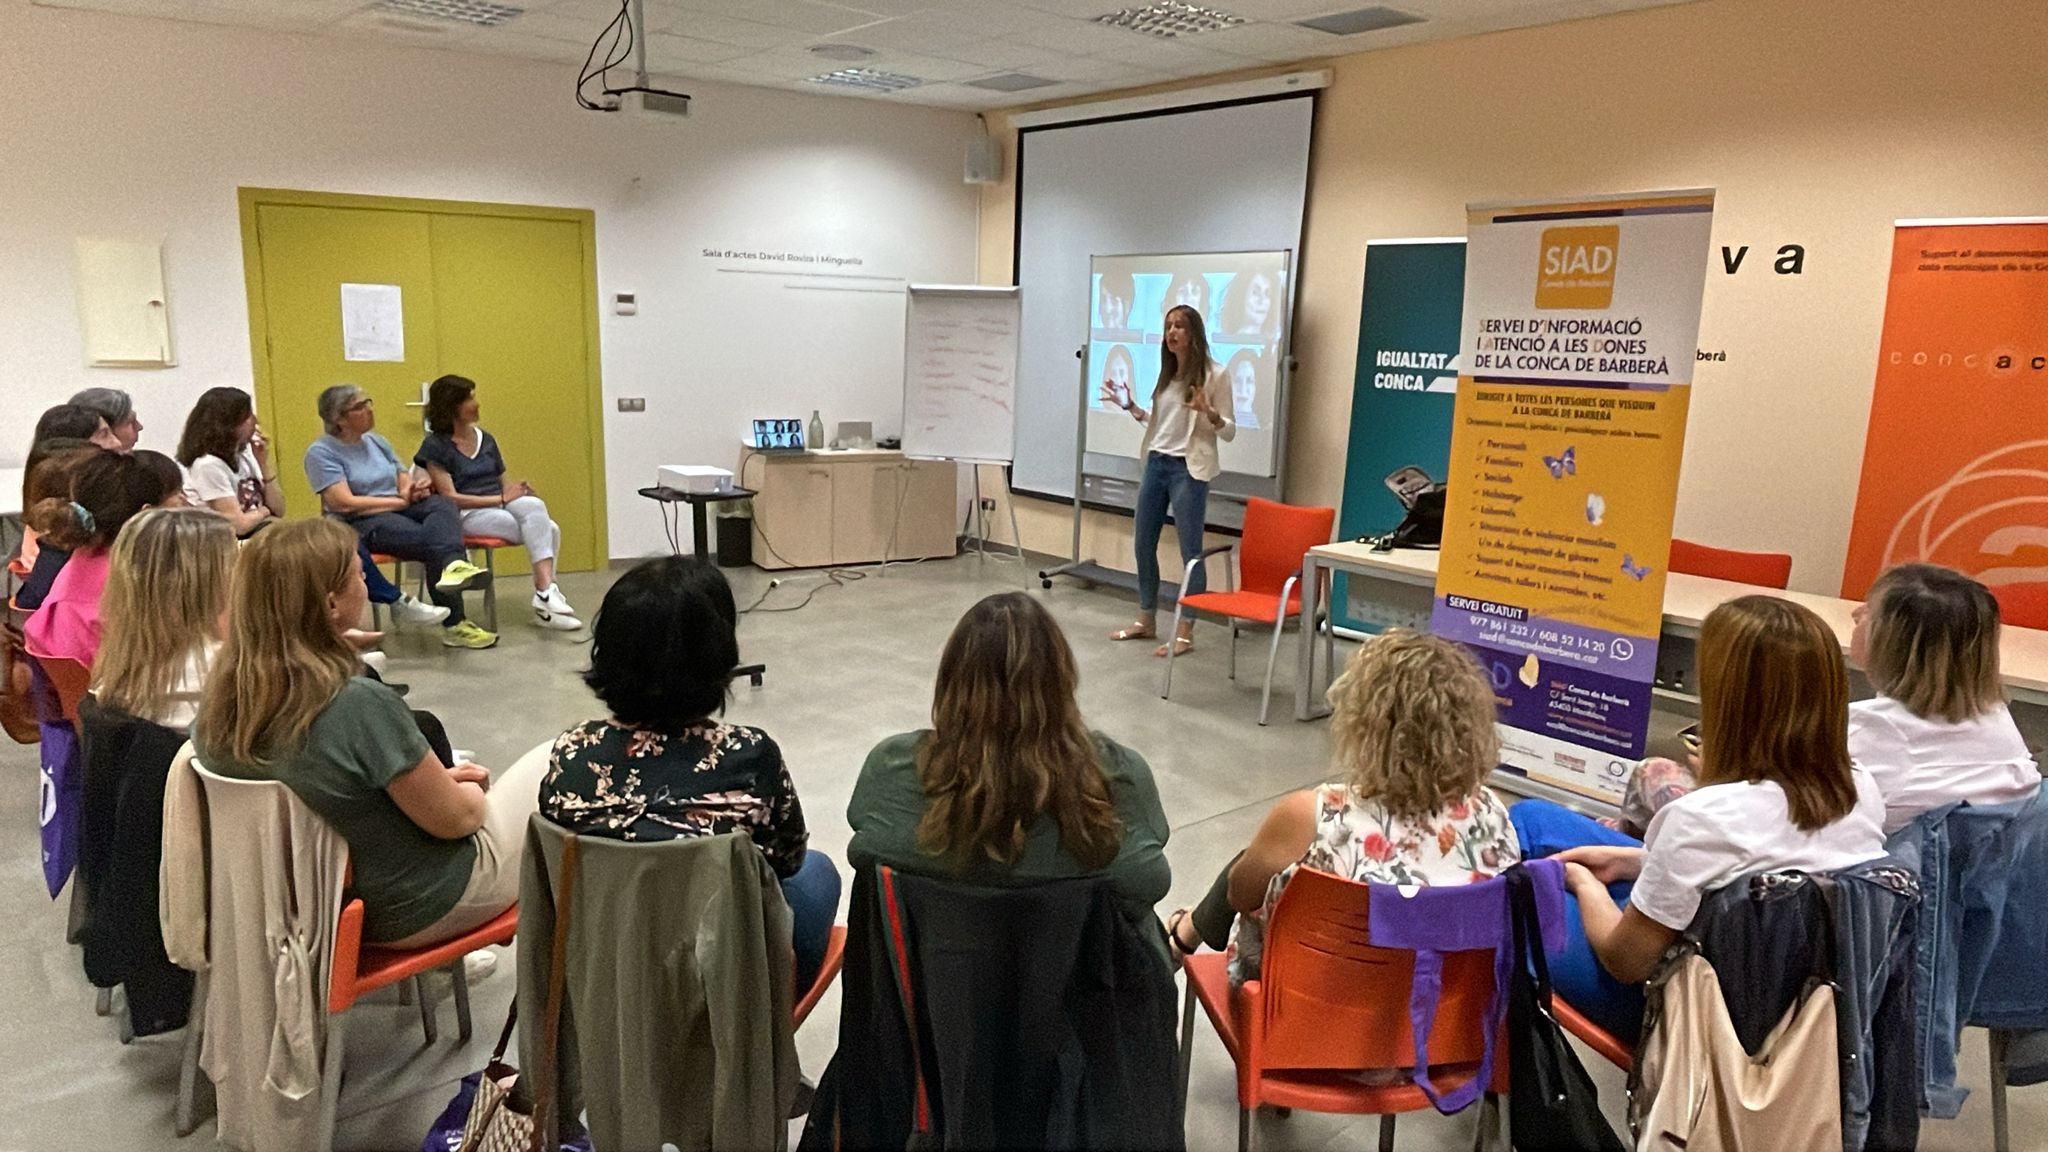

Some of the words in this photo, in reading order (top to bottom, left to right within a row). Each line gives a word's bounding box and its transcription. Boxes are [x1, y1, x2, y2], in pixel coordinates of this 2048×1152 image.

[702, 248, 722, 257] Sala
[725, 249, 756, 259] d'actes
[760, 252, 785, 261] David
[787, 253, 814, 262] Rovira
[1545, 246, 1612, 275] SIAD
[1479, 319, 1524, 333] SERVEI
[1529, 317, 1642, 335] D'INFORMACIÓ
[1477, 337, 1481, 350] I
[1484, 335, 1546, 352] ATENCIÓ
[1548, 338, 1560, 352] A
[1564, 339, 1588, 353] LES
[1593, 340, 1647, 354] DONES
[1376, 350, 1448, 370] IGUALTAT
[1696, 348, 1727, 362] berà
[1475, 355, 1491, 368] DE
[1495, 355, 1512, 369] LA
[1516, 356, 1570, 371] CONCA
[1575, 358, 1594, 372] DE
[1599, 356, 1669, 375] BARBERÀ
[1374, 372, 1425, 392] CONCA
[1506, 393, 1513, 402] A
[1516, 393, 1537, 404] TOTES
[1540, 395, 1553, 405] LES
[1555, 396, 1597, 407] PERSONES
[1599, 398, 1616, 409] QUE
[1619, 399, 1656, 411] VISQUIN
[1512, 406, 1518, 415] A
[1520, 406, 1530, 415] LA
[1532, 407, 1559, 417] CONCA
[1561, 408, 1571, 419] DE
[1449, 596, 1480, 611] SERVEI
[1481, 602, 1523, 620] GRATUIT
[1469, 615, 1488, 627] 977
[1510, 624, 1529, 636] 232
[1539, 630, 1558, 642] 608
[1561, 634, 1575, 646] 52
[1578, 636, 1590, 649] 14
[1592, 641, 1606, 653] 20
